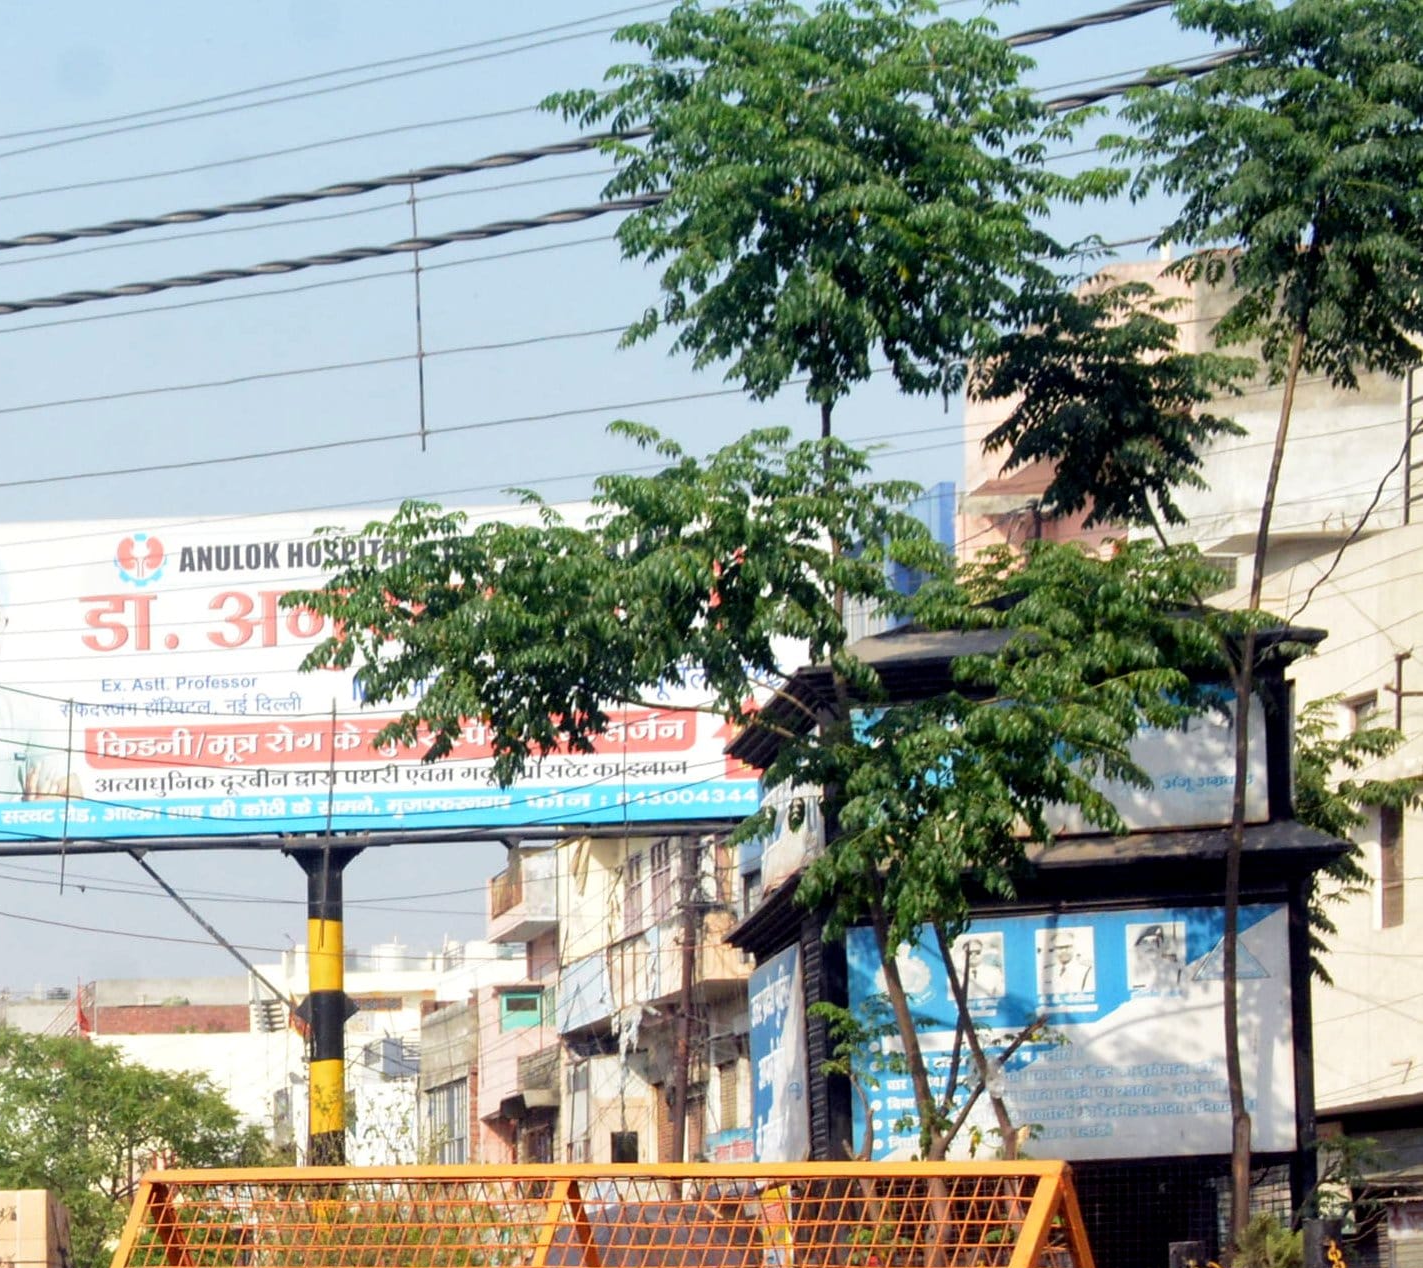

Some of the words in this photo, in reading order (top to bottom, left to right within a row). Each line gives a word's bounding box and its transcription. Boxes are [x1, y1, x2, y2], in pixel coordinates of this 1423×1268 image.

[179, 543, 280, 573] ANULOK
[287, 538, 408, 570] HOSPITA
[79, 593, 180, 652] डा.
[102, 678, 128, 693] Ex.
[134, 677, 171, 692] Astt.
[175, 676, 258, 692] Professor
[225, 697, 248, 715] नई
[255, 691, 302, 712] दिल्ली
[95, 727, 258, 763] किडनी/मूत्र
[265, 724, 321, 752] रोग
[333, 722, 361, 751] के
[94, 771, 214, 797] अत्याधुनिक
[221, 767, 288, 796] दूरबीन
[343, 764, 400, 787] पथरी
[593, 759, 621, 778] का
